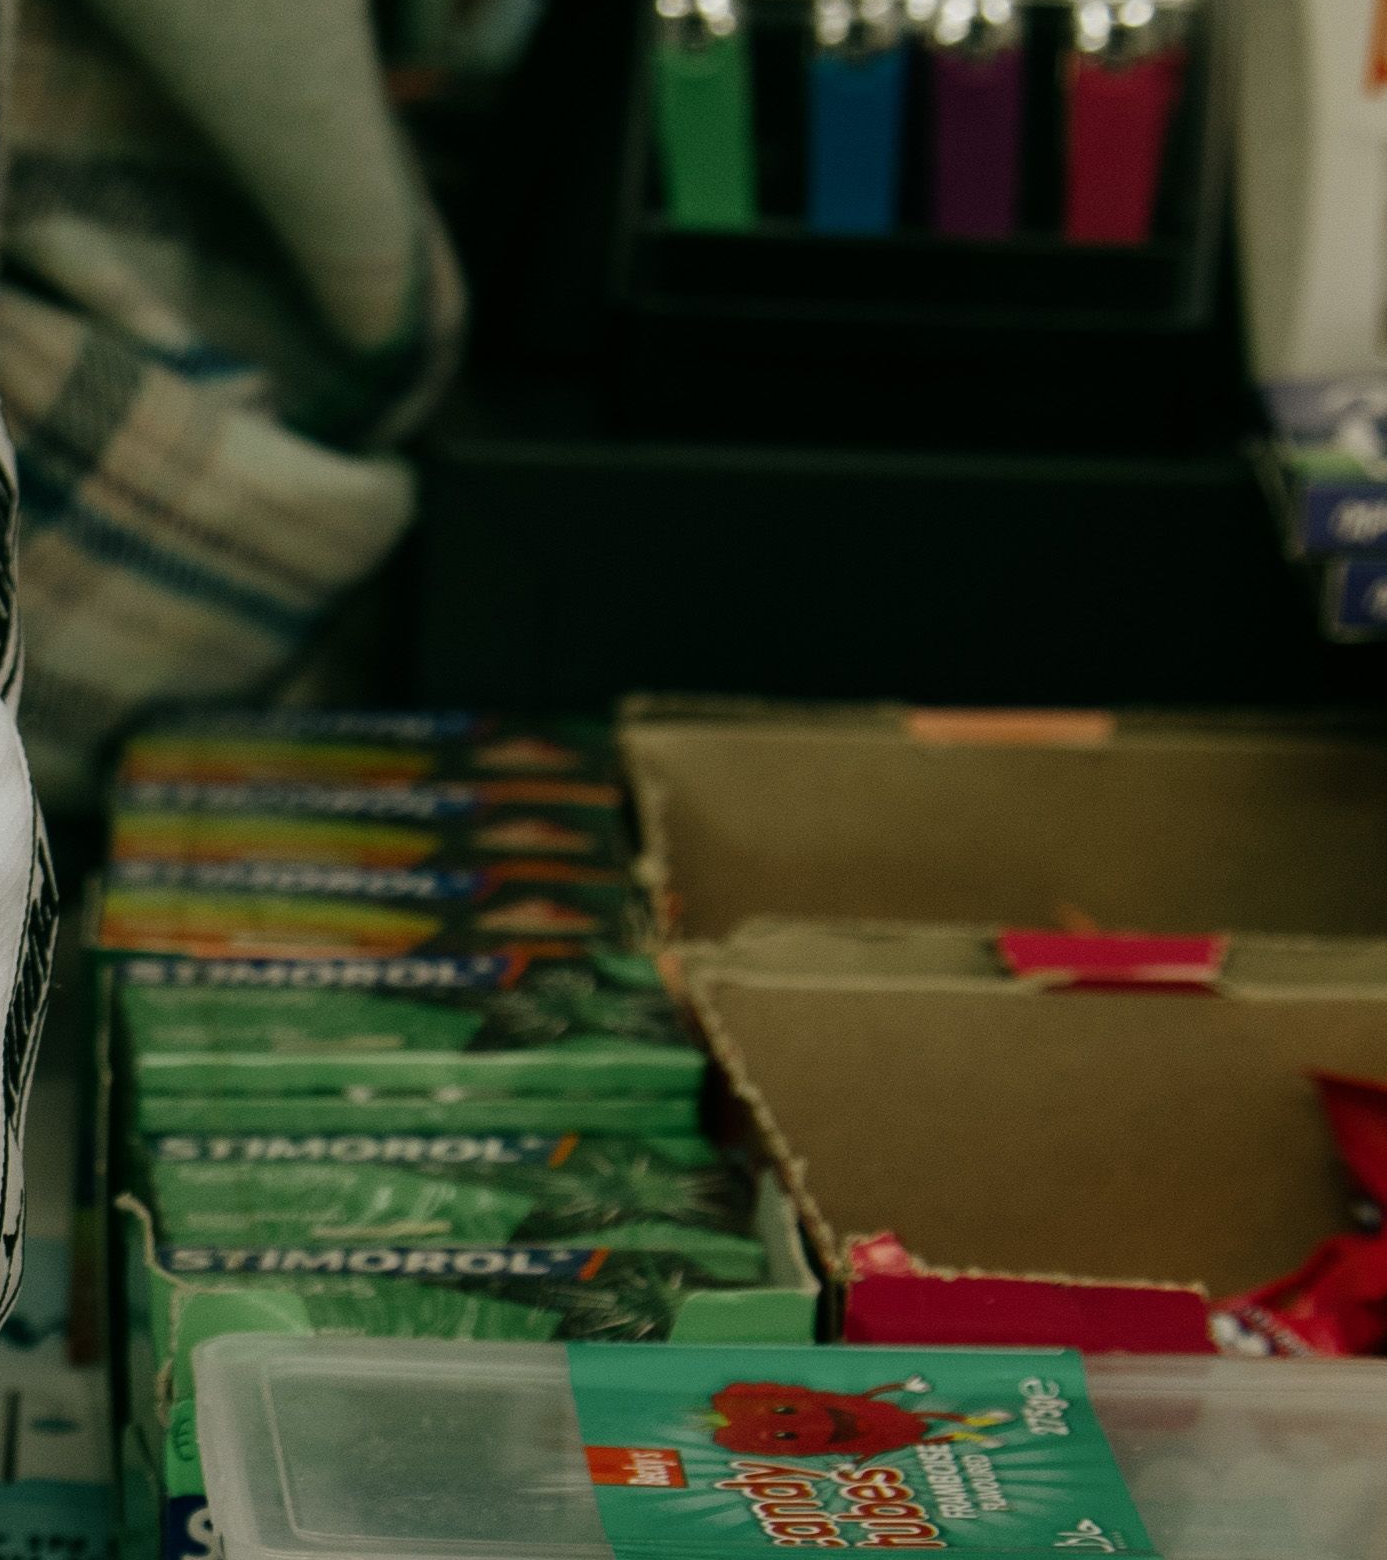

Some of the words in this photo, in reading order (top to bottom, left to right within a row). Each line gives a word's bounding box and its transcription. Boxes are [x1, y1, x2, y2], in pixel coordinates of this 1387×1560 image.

[127, 958, 473, 988] STIMOROL
[158, 1137, 521, 1163] STIMOROL
[168, 1249, 550, 1275] STIMOROL
[714, 1460, 848, 1548] andy
